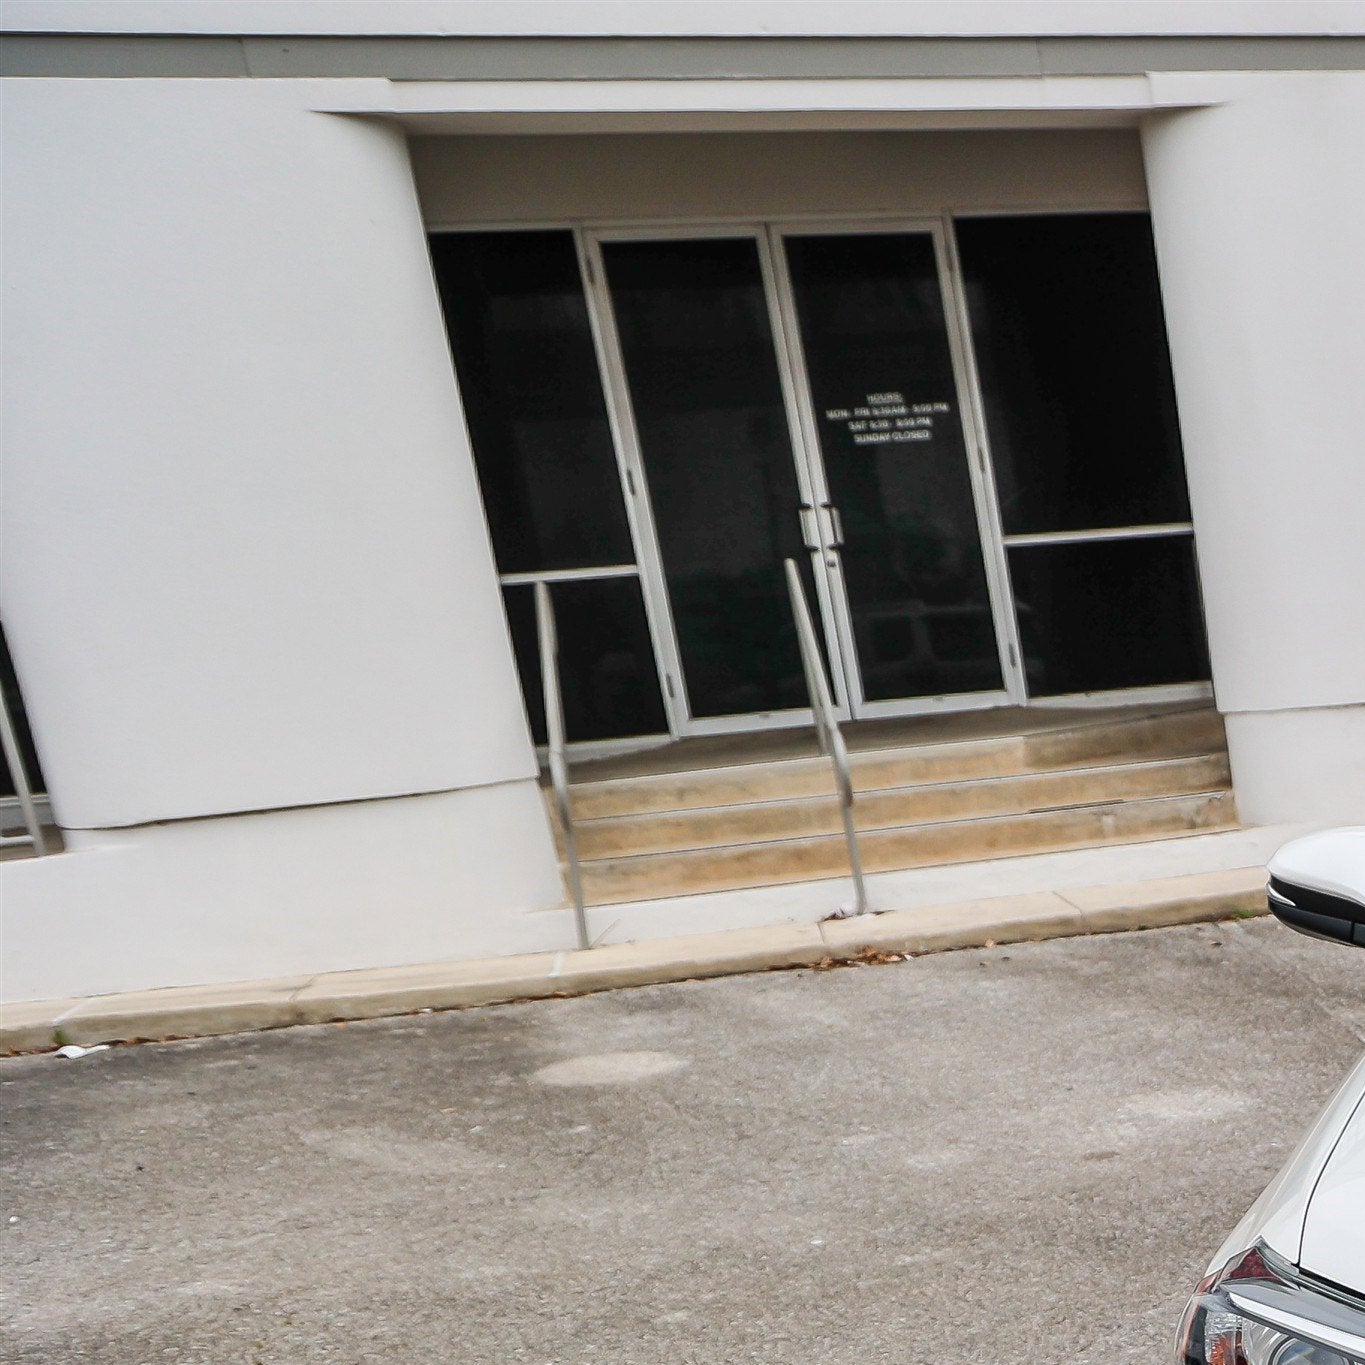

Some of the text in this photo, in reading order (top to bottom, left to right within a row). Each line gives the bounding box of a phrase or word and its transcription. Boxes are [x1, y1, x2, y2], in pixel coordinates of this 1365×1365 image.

[933, 402, 950, 413] PM
[848, 421, 867, 432] SAT
[853, 430, 932, 445] SUNDAY CLOSED
